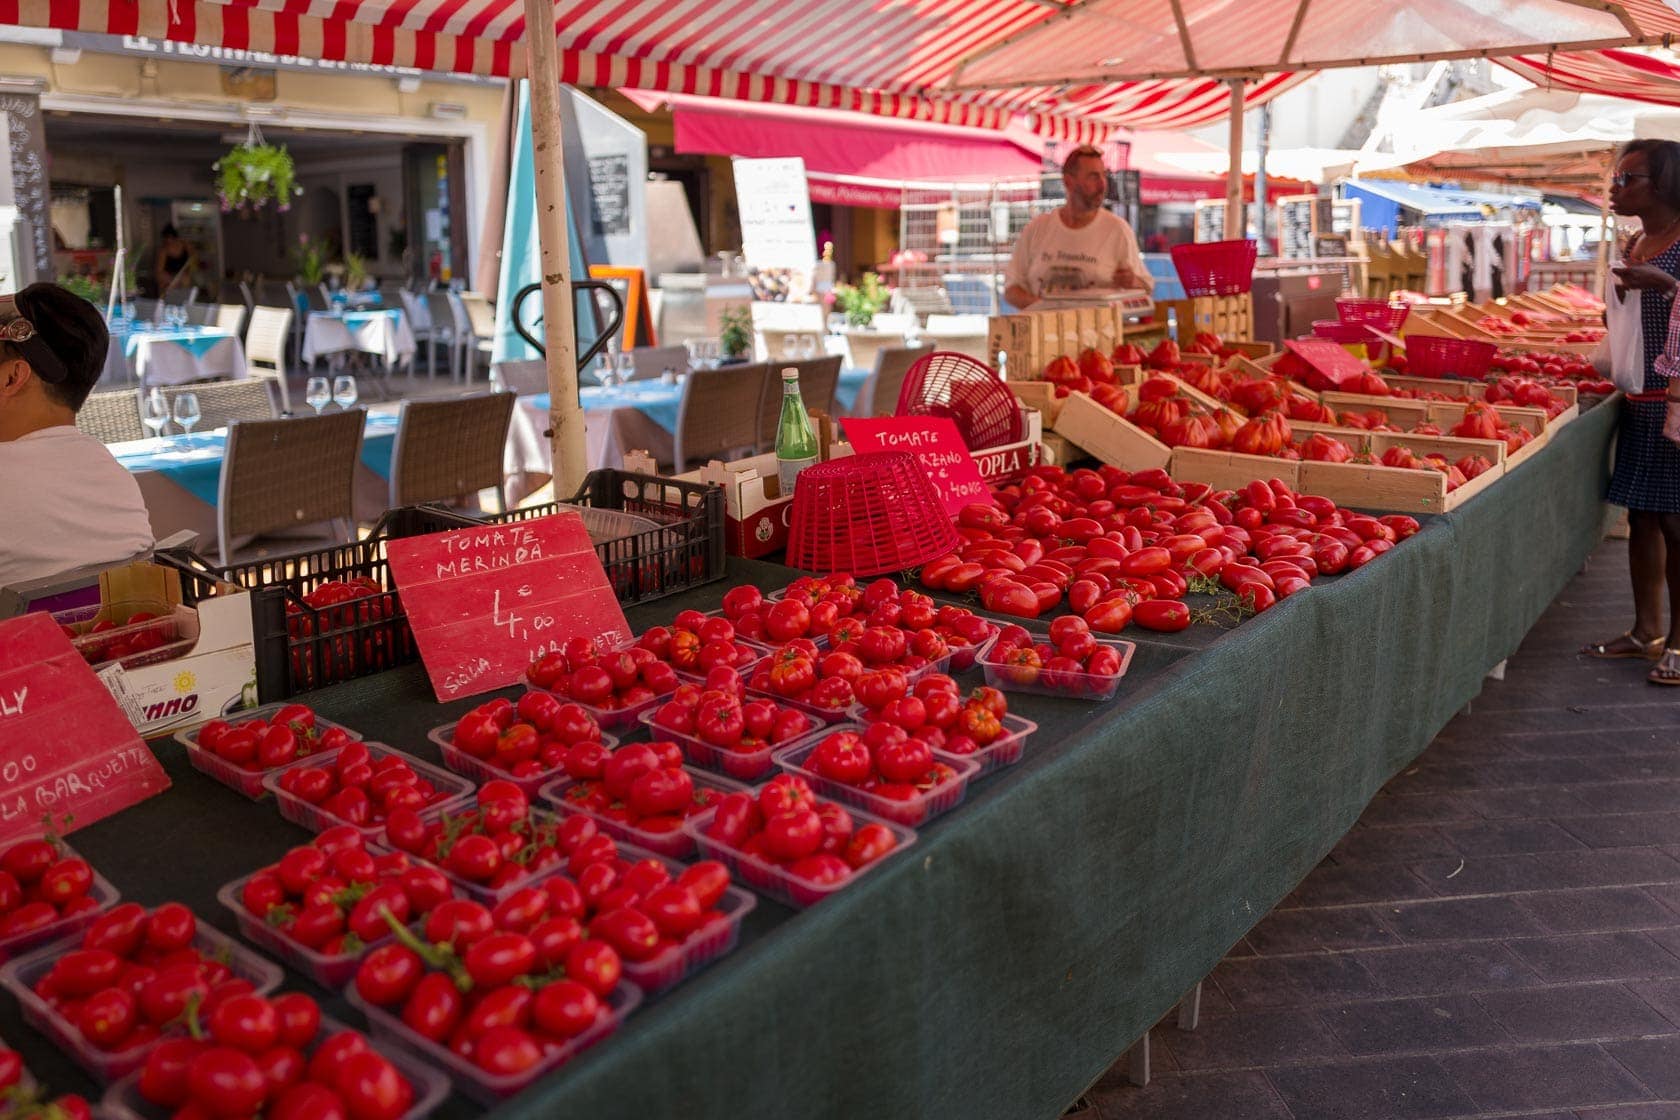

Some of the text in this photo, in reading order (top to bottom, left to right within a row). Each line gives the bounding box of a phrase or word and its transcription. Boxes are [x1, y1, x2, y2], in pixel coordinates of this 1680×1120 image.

[875, 431, 939, 446] TOMATE
[919, 450, 962, 467] RZANO
[975, 451, 1020, 478] OPLA
[441, 526, 539, 553] TOMATE
[0, 686, 28, 717] LY
[2, 747, 149, 821] LA BARQUETTE
